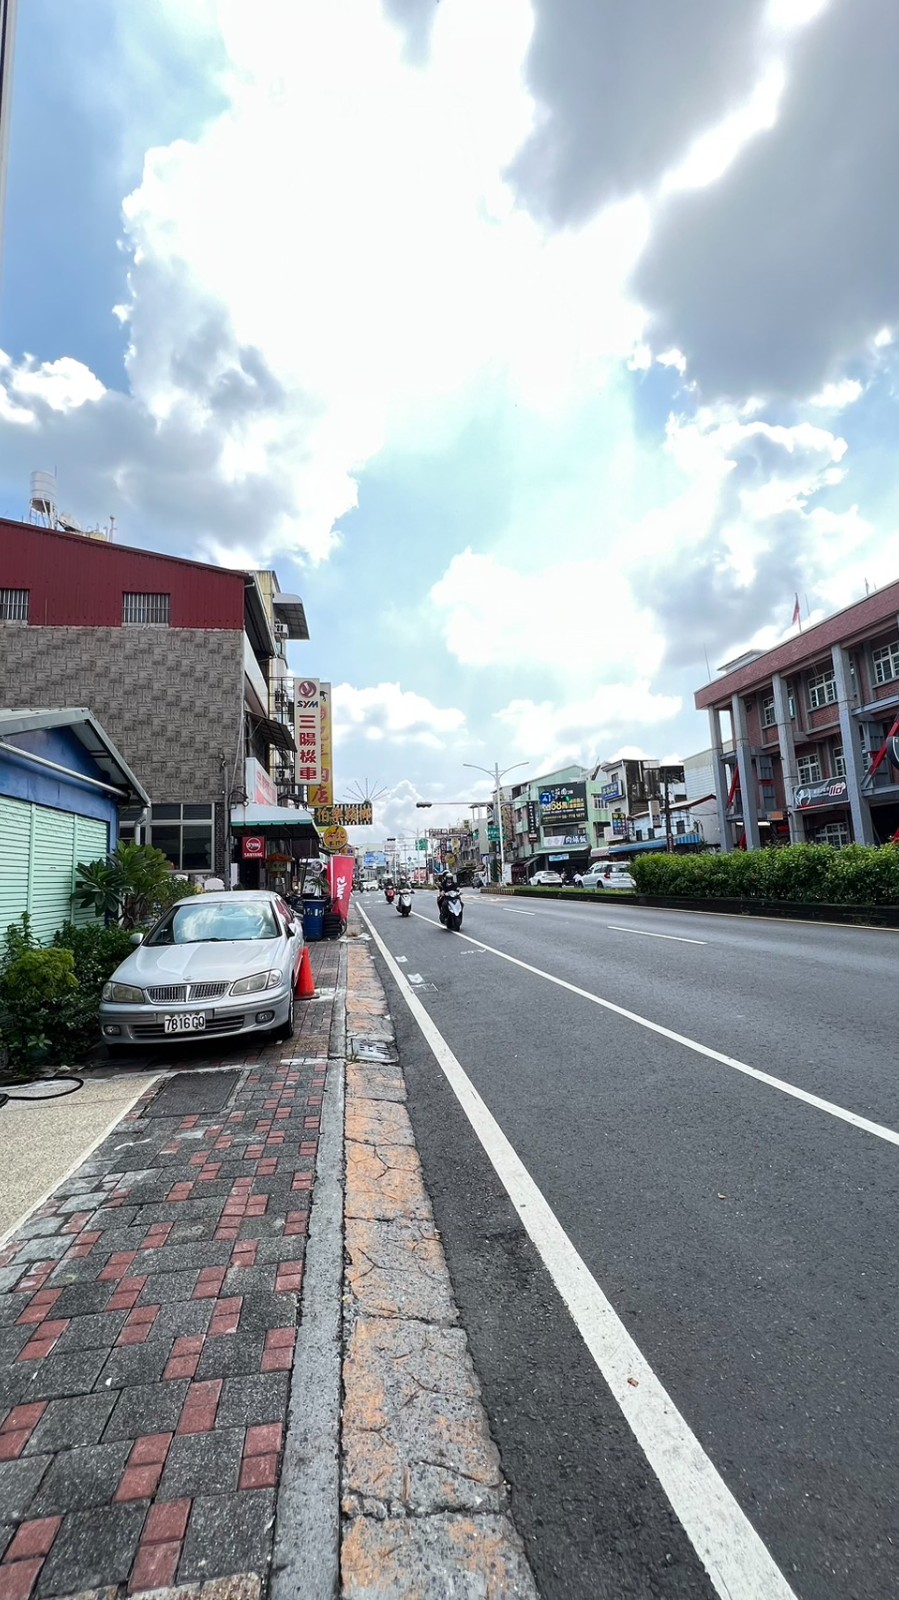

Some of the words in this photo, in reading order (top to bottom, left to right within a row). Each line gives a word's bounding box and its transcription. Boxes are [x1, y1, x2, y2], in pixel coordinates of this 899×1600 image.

[297, 700, 318, 708] SYM
[299, 714, 317, 780] 三陽機車
